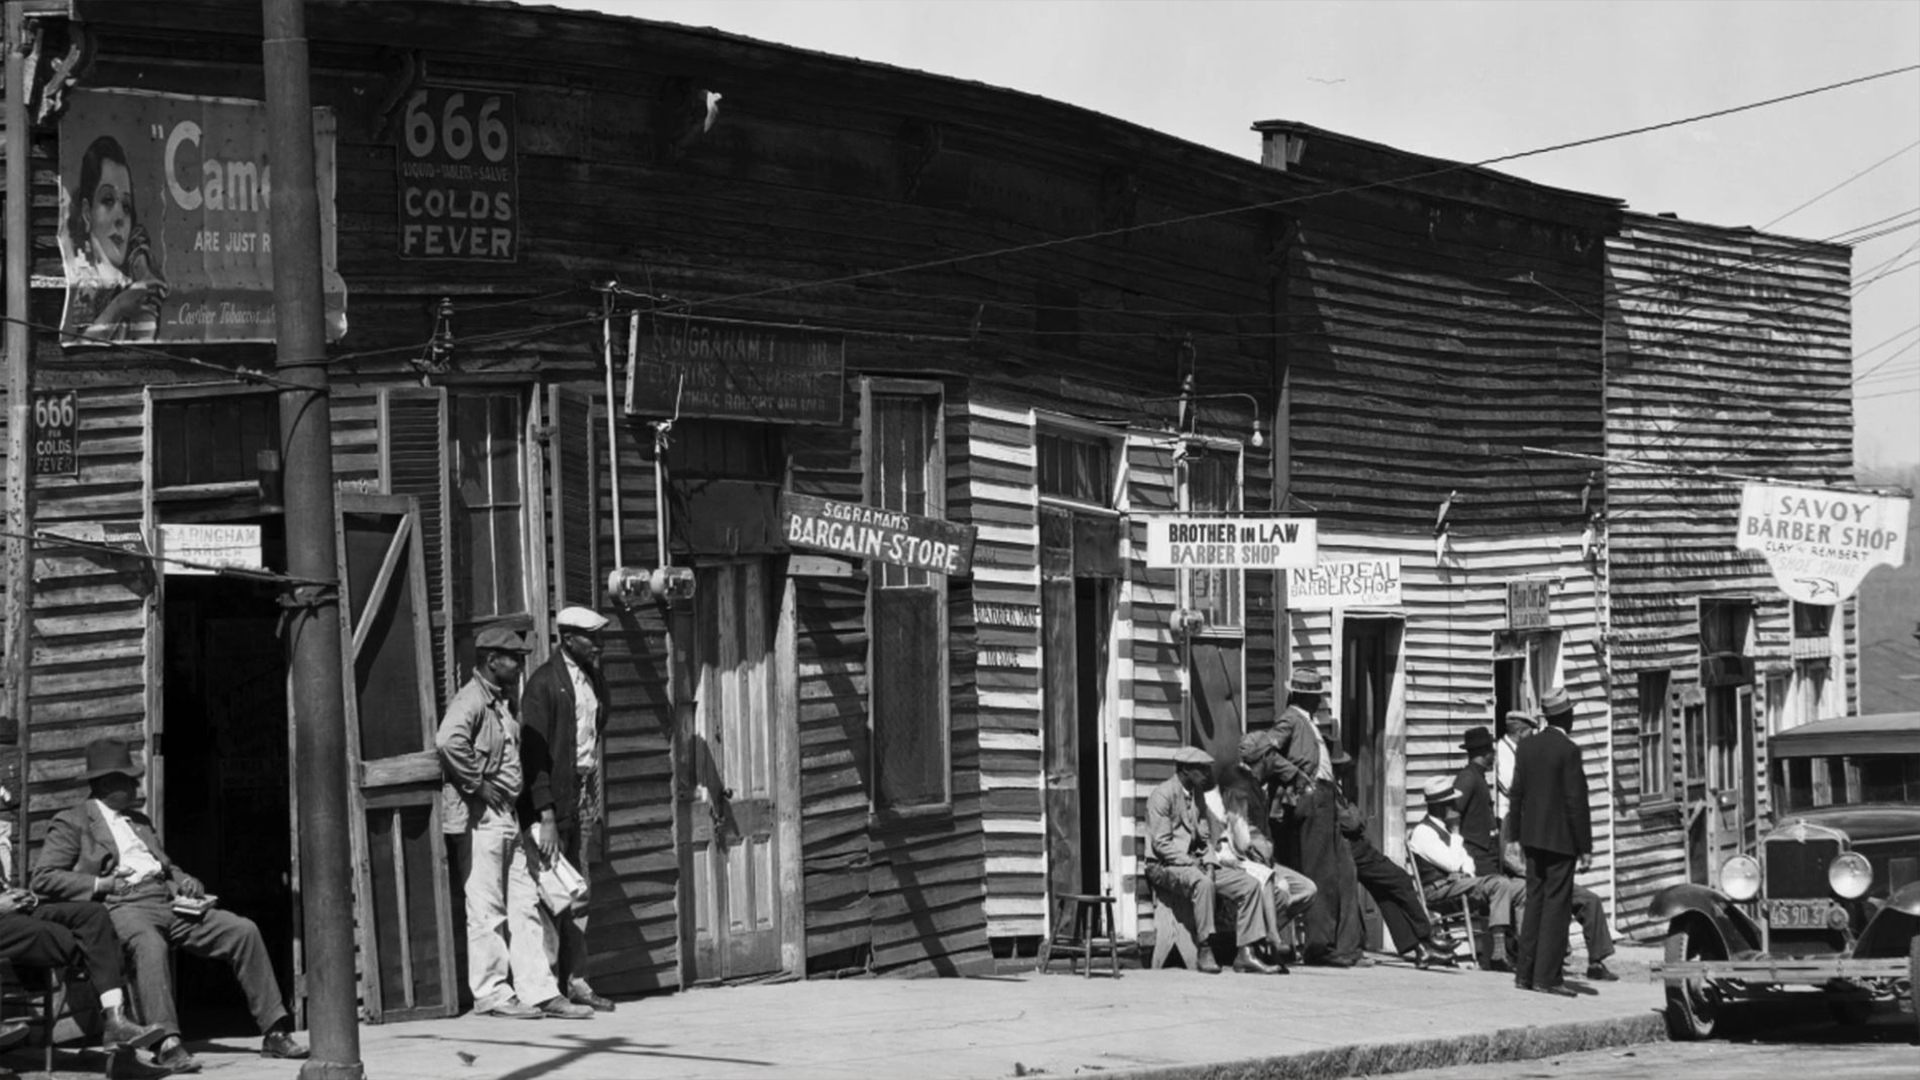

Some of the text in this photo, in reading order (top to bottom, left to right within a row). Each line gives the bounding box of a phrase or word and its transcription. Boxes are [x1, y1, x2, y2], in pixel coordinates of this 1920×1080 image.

[404, 89, 509, 163] 666
[405, 185, 512, 221] COLDS
[194, 231, 220, 252] ARE
[225, 231, 257, 253] JUST
[404, 224, 512, 258] FEVER
[36, 394, 74, 429] 666
[36, 439, 72, 456] COLDS
[36, 457, 73, 472] FEVER
[1779, 496, 1870, 523] SAVOY
[1169, 523, 1236, 544] BROTHER
[1259, 523, 1299, 543] LAW
[1746, 515, 1898, 551] BARBER SHOP
[1171, 545, 1280, 564] BARBER SHOP
[1765, 541, 1794, 553] CLAY
[1811, 546, 1870, 561] REMBERT
